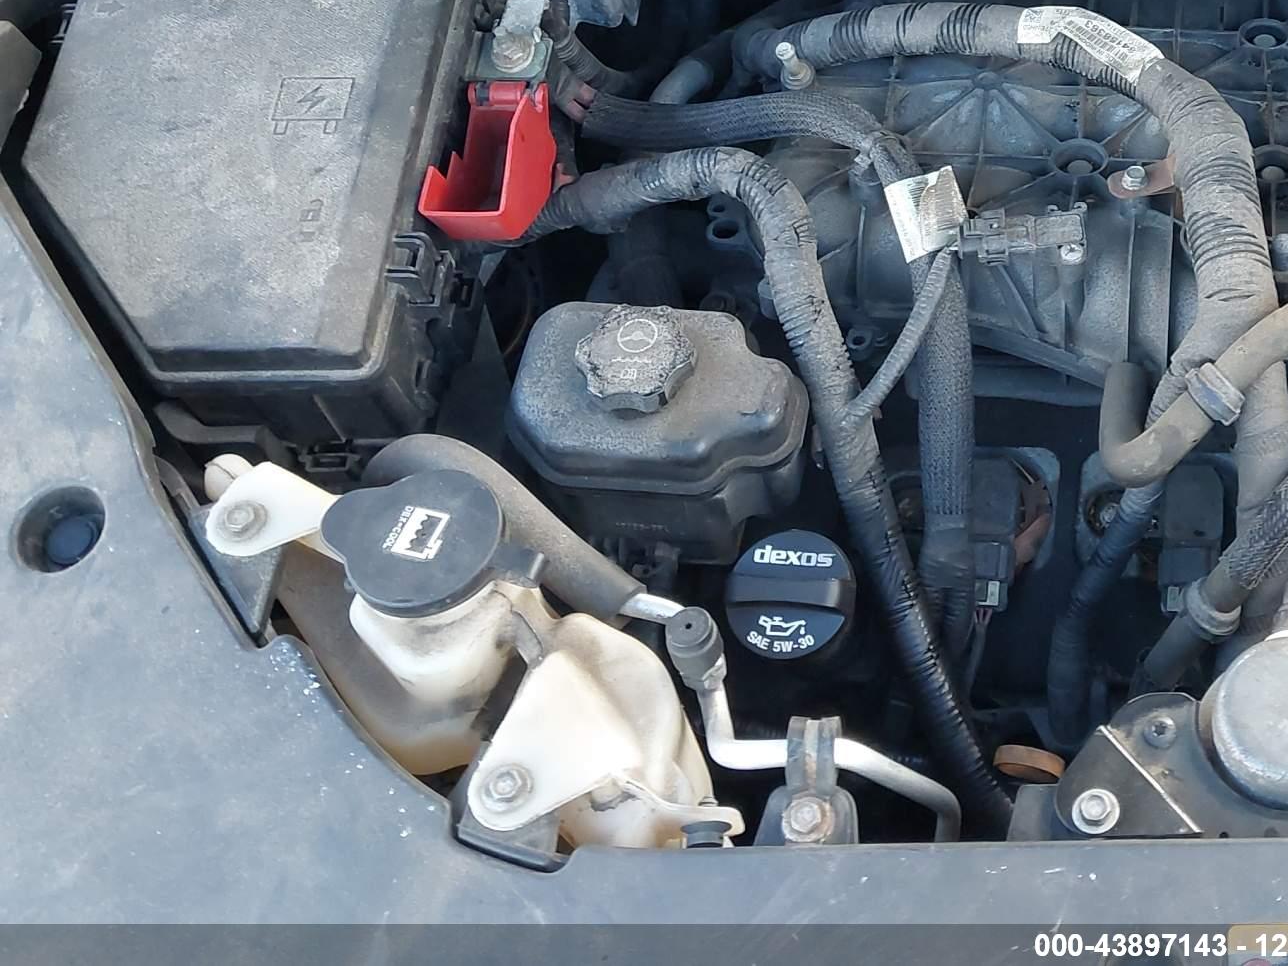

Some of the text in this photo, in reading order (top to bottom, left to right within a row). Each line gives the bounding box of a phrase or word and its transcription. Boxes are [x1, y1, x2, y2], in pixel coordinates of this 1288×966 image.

[753, 545, 836, 567] dexos
[746, 631, 815, 652] SAE 5W-30
